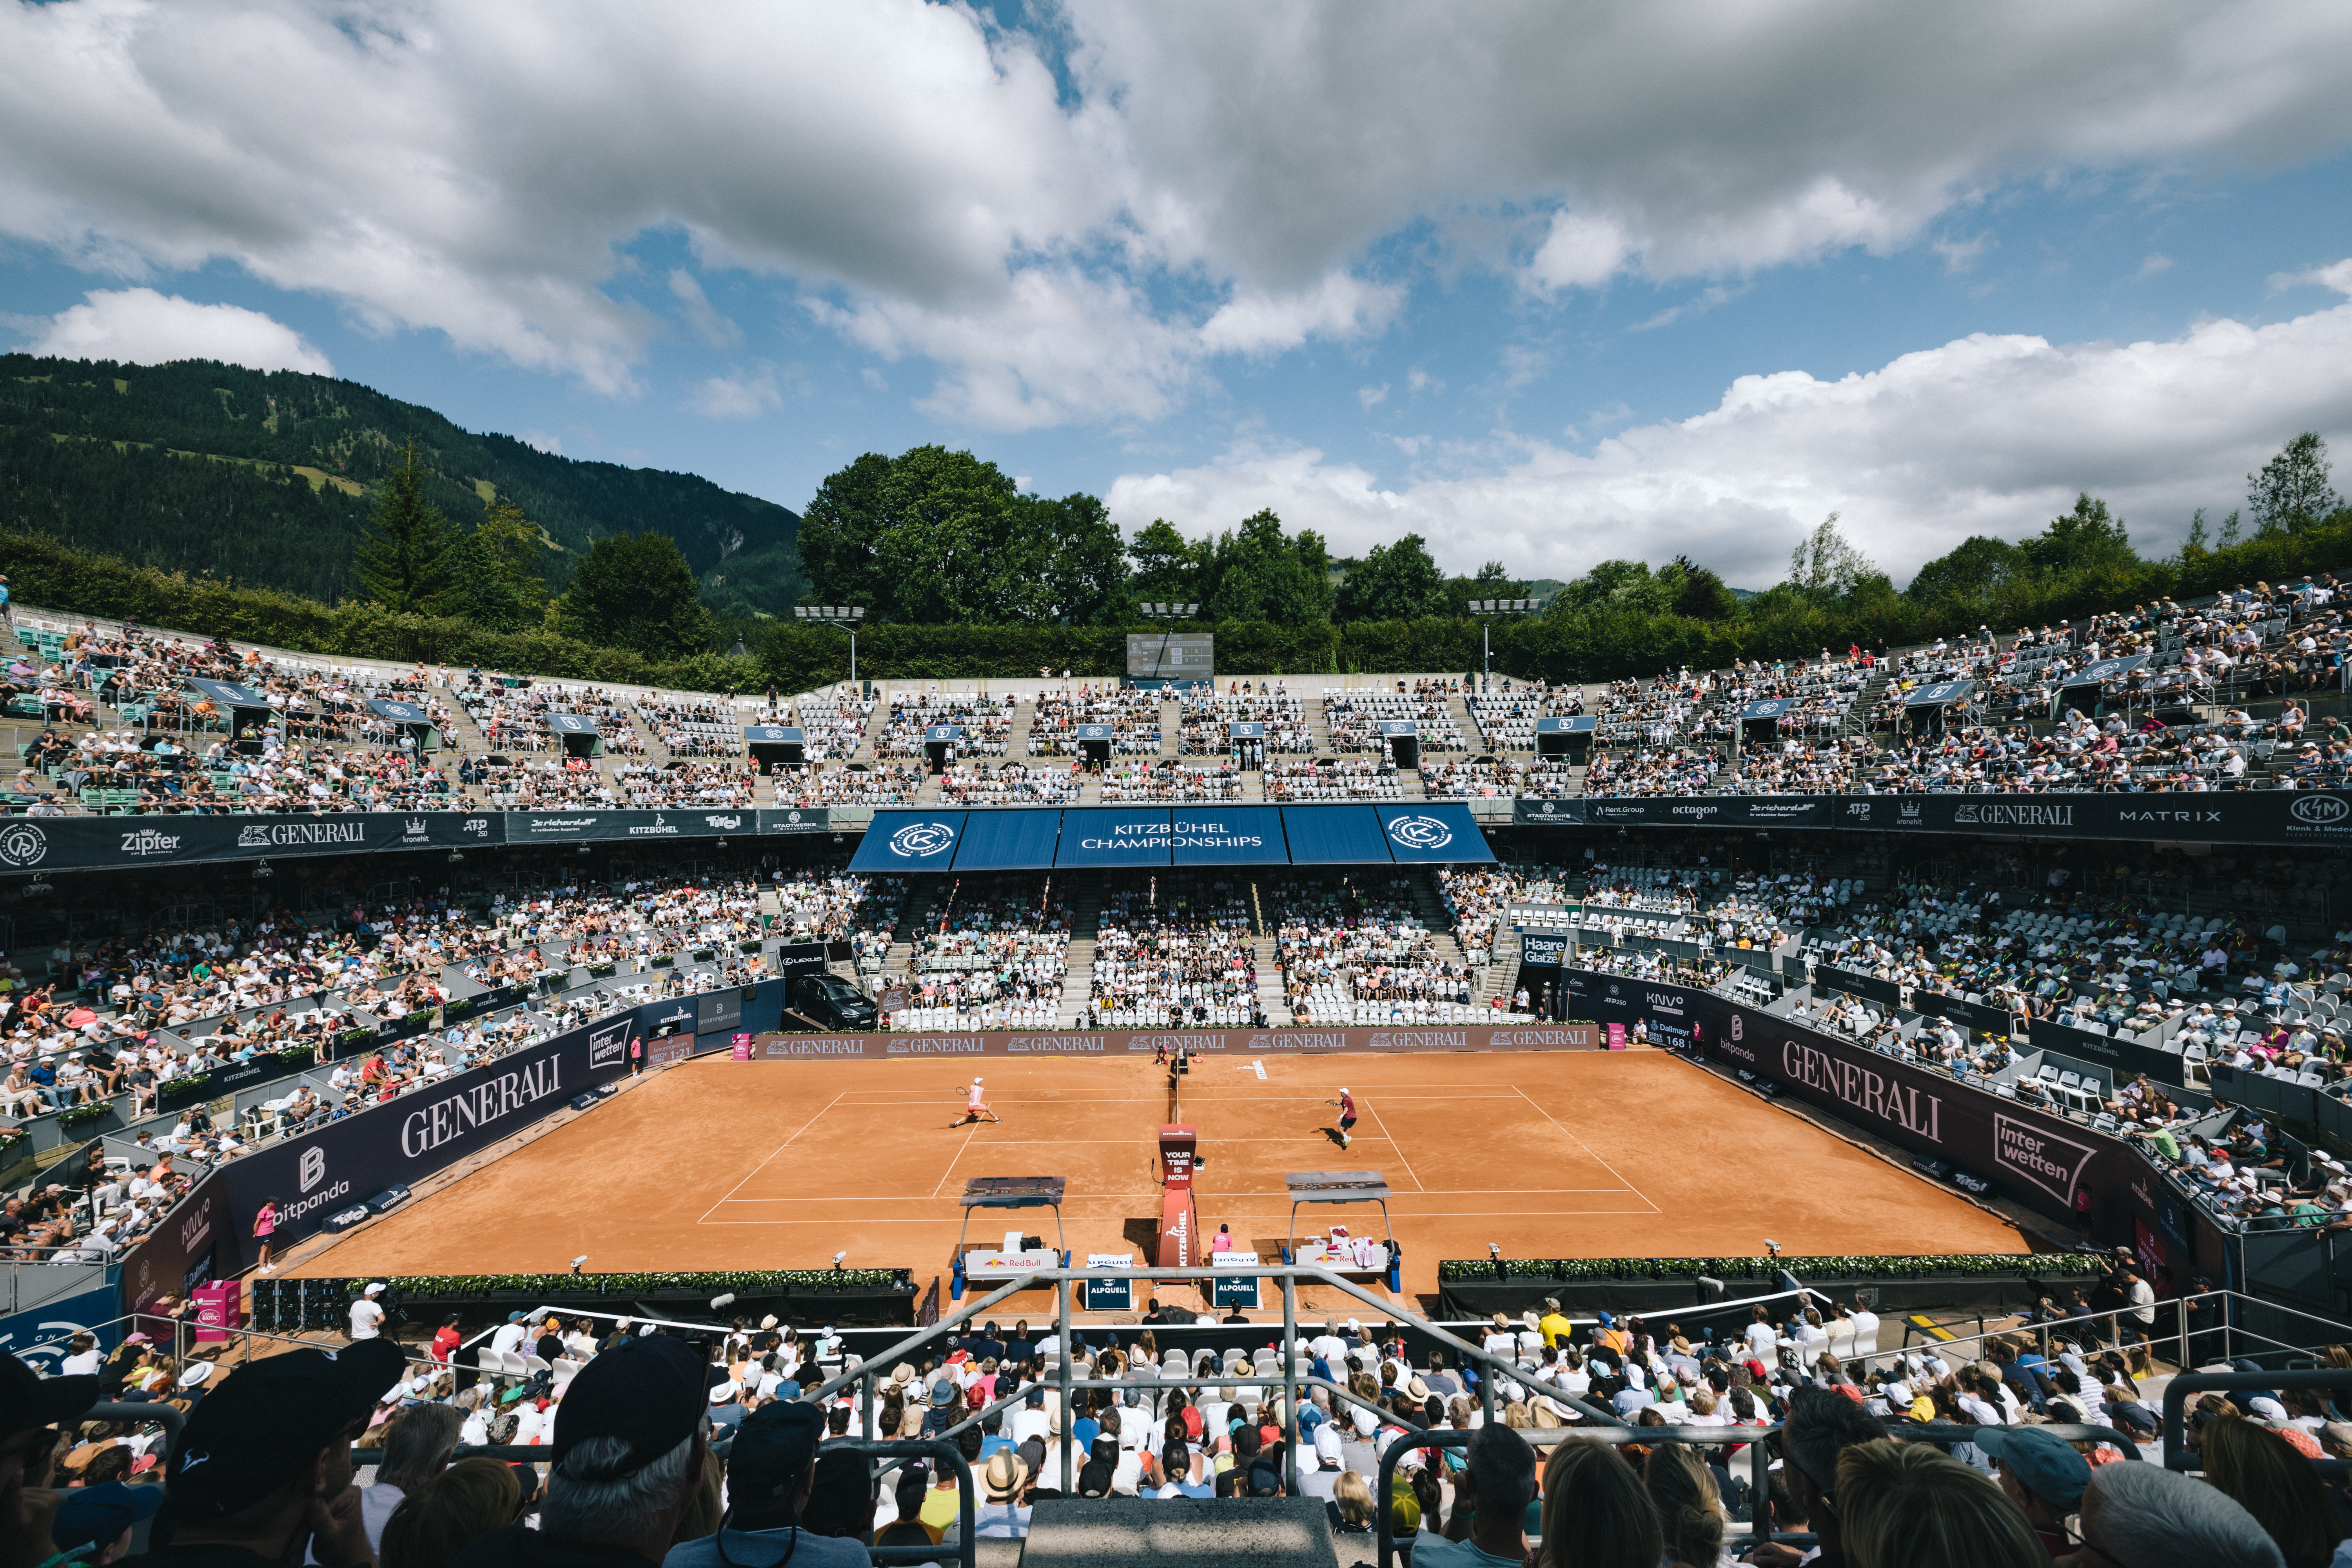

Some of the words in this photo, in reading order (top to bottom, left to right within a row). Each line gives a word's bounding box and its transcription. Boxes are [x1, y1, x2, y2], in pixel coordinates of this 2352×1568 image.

[1672, 806, 1717, 819] octagon
[1846, 804, 1870, 814] ATP
[1981, 805, 2073, 825] GENERALI
[2120, 811, 2221, 821] MATRIX
[463, 819, 487, 831] ATP
[706, 815, 740, 829] Tirol
[1115, 822, 1229, 835] KITZBÜHEL
[272, 823, 365, 845] GENERALI
[629, 826, 678, 834] KITZBÜHEL
[1395, 819, 1412, 838] KITZBÜHEL
[1419, 819, 1445, 845] CHAMPIONSHIPS
[897, 827, 923, 846] KITZBÜHEL
[920, 827, 947, 853] CHAMPIONSHIPS
[1082, 836, 1262, 849] CHAMPIONSHIPS
[1525, 937, 1564, 951] Haare
[1525, 951, 1558, 964] Glatze
[1845, 980, 1865, 989] KITZBÜHEL
[477, 998, 498, 1007] KITZBÜHEL
[661, 1013, 693, 1024] KITZBÜHEL
[698, 1012, 740, 1025] breuninger.com
[1946, 1007, 1973, 1018] KITZBÜHEL
[1660, 1024, 1690, 1036] Dallmayr
[593, 1034, 613, 1051] inter
[1031, 1037, 1105, 1051] GENERALI
[1152, 1035, 1226, 1049] GENERALI
[1272, 1033, 1346, 1048] GENERALI
[1393, 1032, 1467, 1046] GENERALI
[1514, 1031, 1588, 1045] GENERALI
[1667, 1036, 1685, 1048] 168
[595, 1041, 622, 1061] wetten
[653, 1042, 687, 1053] breuninger.com
[789, 1040, 864, 1054] GENERALI
[910, 1038, 984, 1053] GENERALI
[1721, 1037, 1754, 1062] bitpanda
[2083, 1042, 2119, 1056] KITZBÜHEL
[650, 1052, 666, 1060] MATCH
[670, 1047, 690, 1060] 1:21
[224, 1067, 261, 1083] KITZBÜHEL
[1738, 1069, 1755, 1080] Tirol
[599, 1083, 617, 1093] Tirol
[1756, 1083, 1773, 1094] KITZBÜHEL
[1783, 1040, 1942, 1143] GENERALI
[401, 1053, 561, 1158] GENERALI
[580, 1096, 598, 1107] KITZBÜHEL
[2000, 1127, 2045, 1153] inter
[1913, 1160, 1940, 1177] KITZBÜHEL
[2004, 1144, 2068, 1182] wetten
[1955, 1174, 1987, 1192] Tirol
[381, 1190, 410, 1209] KITZBÜHEL
[2132, 1182, 2154, 1209] KITZBÜHEL
[332, 1205, 369, 1225] Tirol
[2160, 1216, 2187, 1248] breuninger.com
[2139, 1246, 2151, 1265] MATCH
[2140, 1237, 2165, 1267] breuninger.com
[189, 1255, 211, 1287] Dallmayr
[958, 1356, 968, 1366] EAM
